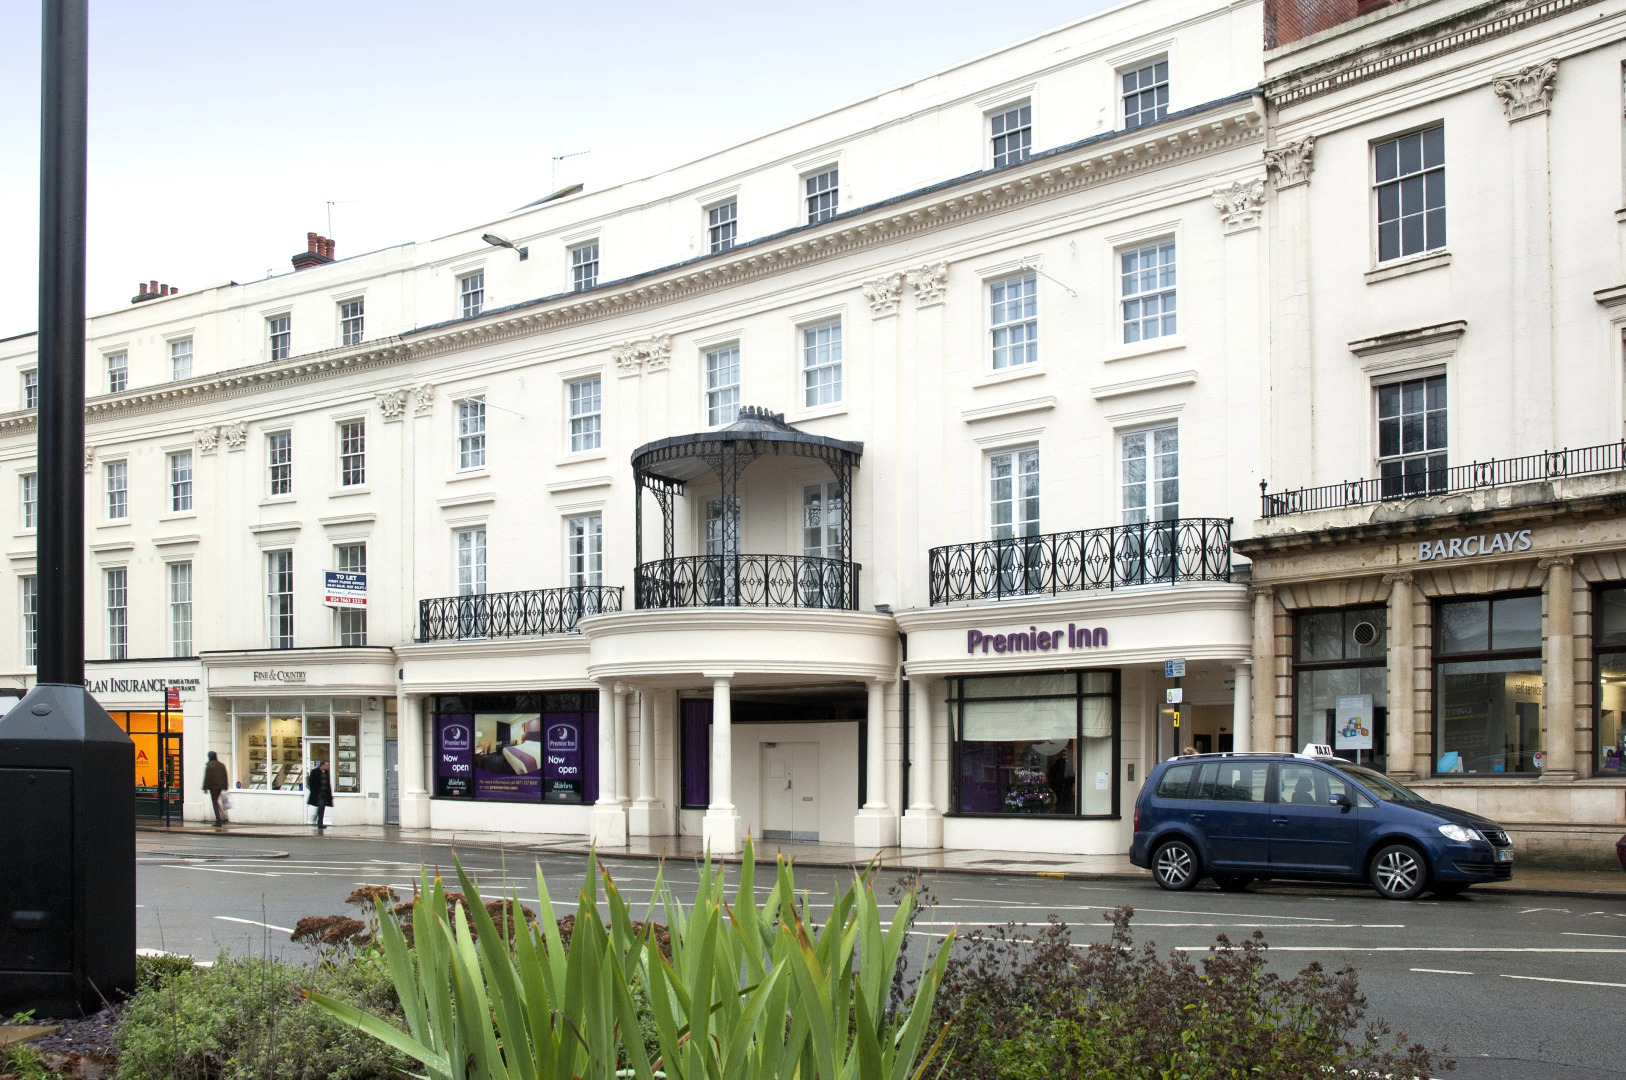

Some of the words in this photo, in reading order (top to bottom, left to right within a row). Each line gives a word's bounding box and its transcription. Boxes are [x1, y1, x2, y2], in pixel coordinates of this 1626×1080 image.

[1418, 529, 1532, 560] BARCLAYS
[967, 625, 1064, 653] Premier
[1068, 623, 1108, 648] Inn
[254, 672, 268, 681] FINE
[269, 669, 276, 681] &
[277, 671, 306, 681] COUNTRY
[110, 678, 166, 692] INSURANCE
[1515, 681, 1525, 694] self
[1525, 684, 1542, 696] service
[1315, 745, 1331, 756] TAXI
[443, 754, 458, 763] Now
[548, 755, 565, 764] Now
[452, 764, 469, 773] open
[558, 767, 578, 775] open
